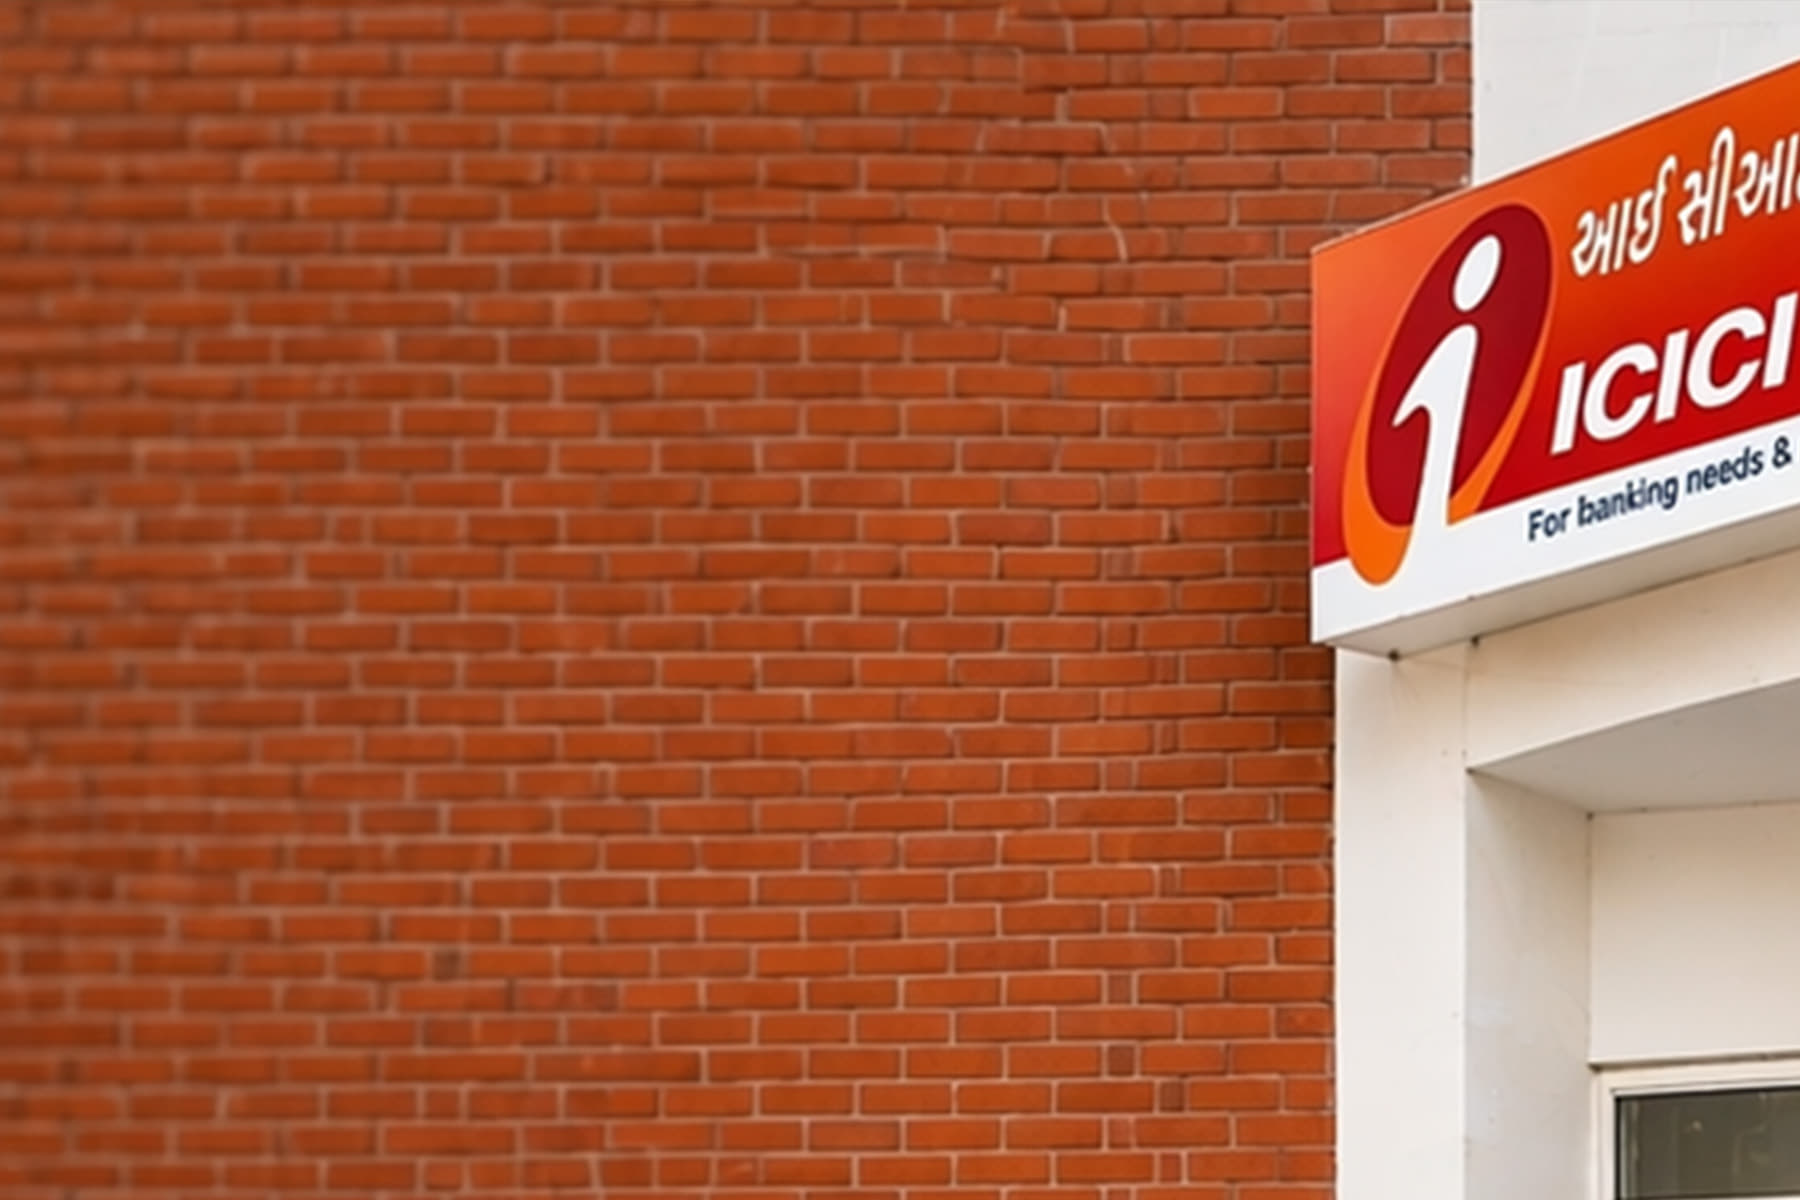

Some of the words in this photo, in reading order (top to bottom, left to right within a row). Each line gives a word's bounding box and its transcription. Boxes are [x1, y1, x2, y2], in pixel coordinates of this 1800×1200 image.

[1550, 291, 1799, 455] ICICI
[1527, 507, 1572, 542] For
[1576, 476, 1680, 527] banking
[1685, 446, 1765, 495] needs
[1771, 435, 1793, 470] &
